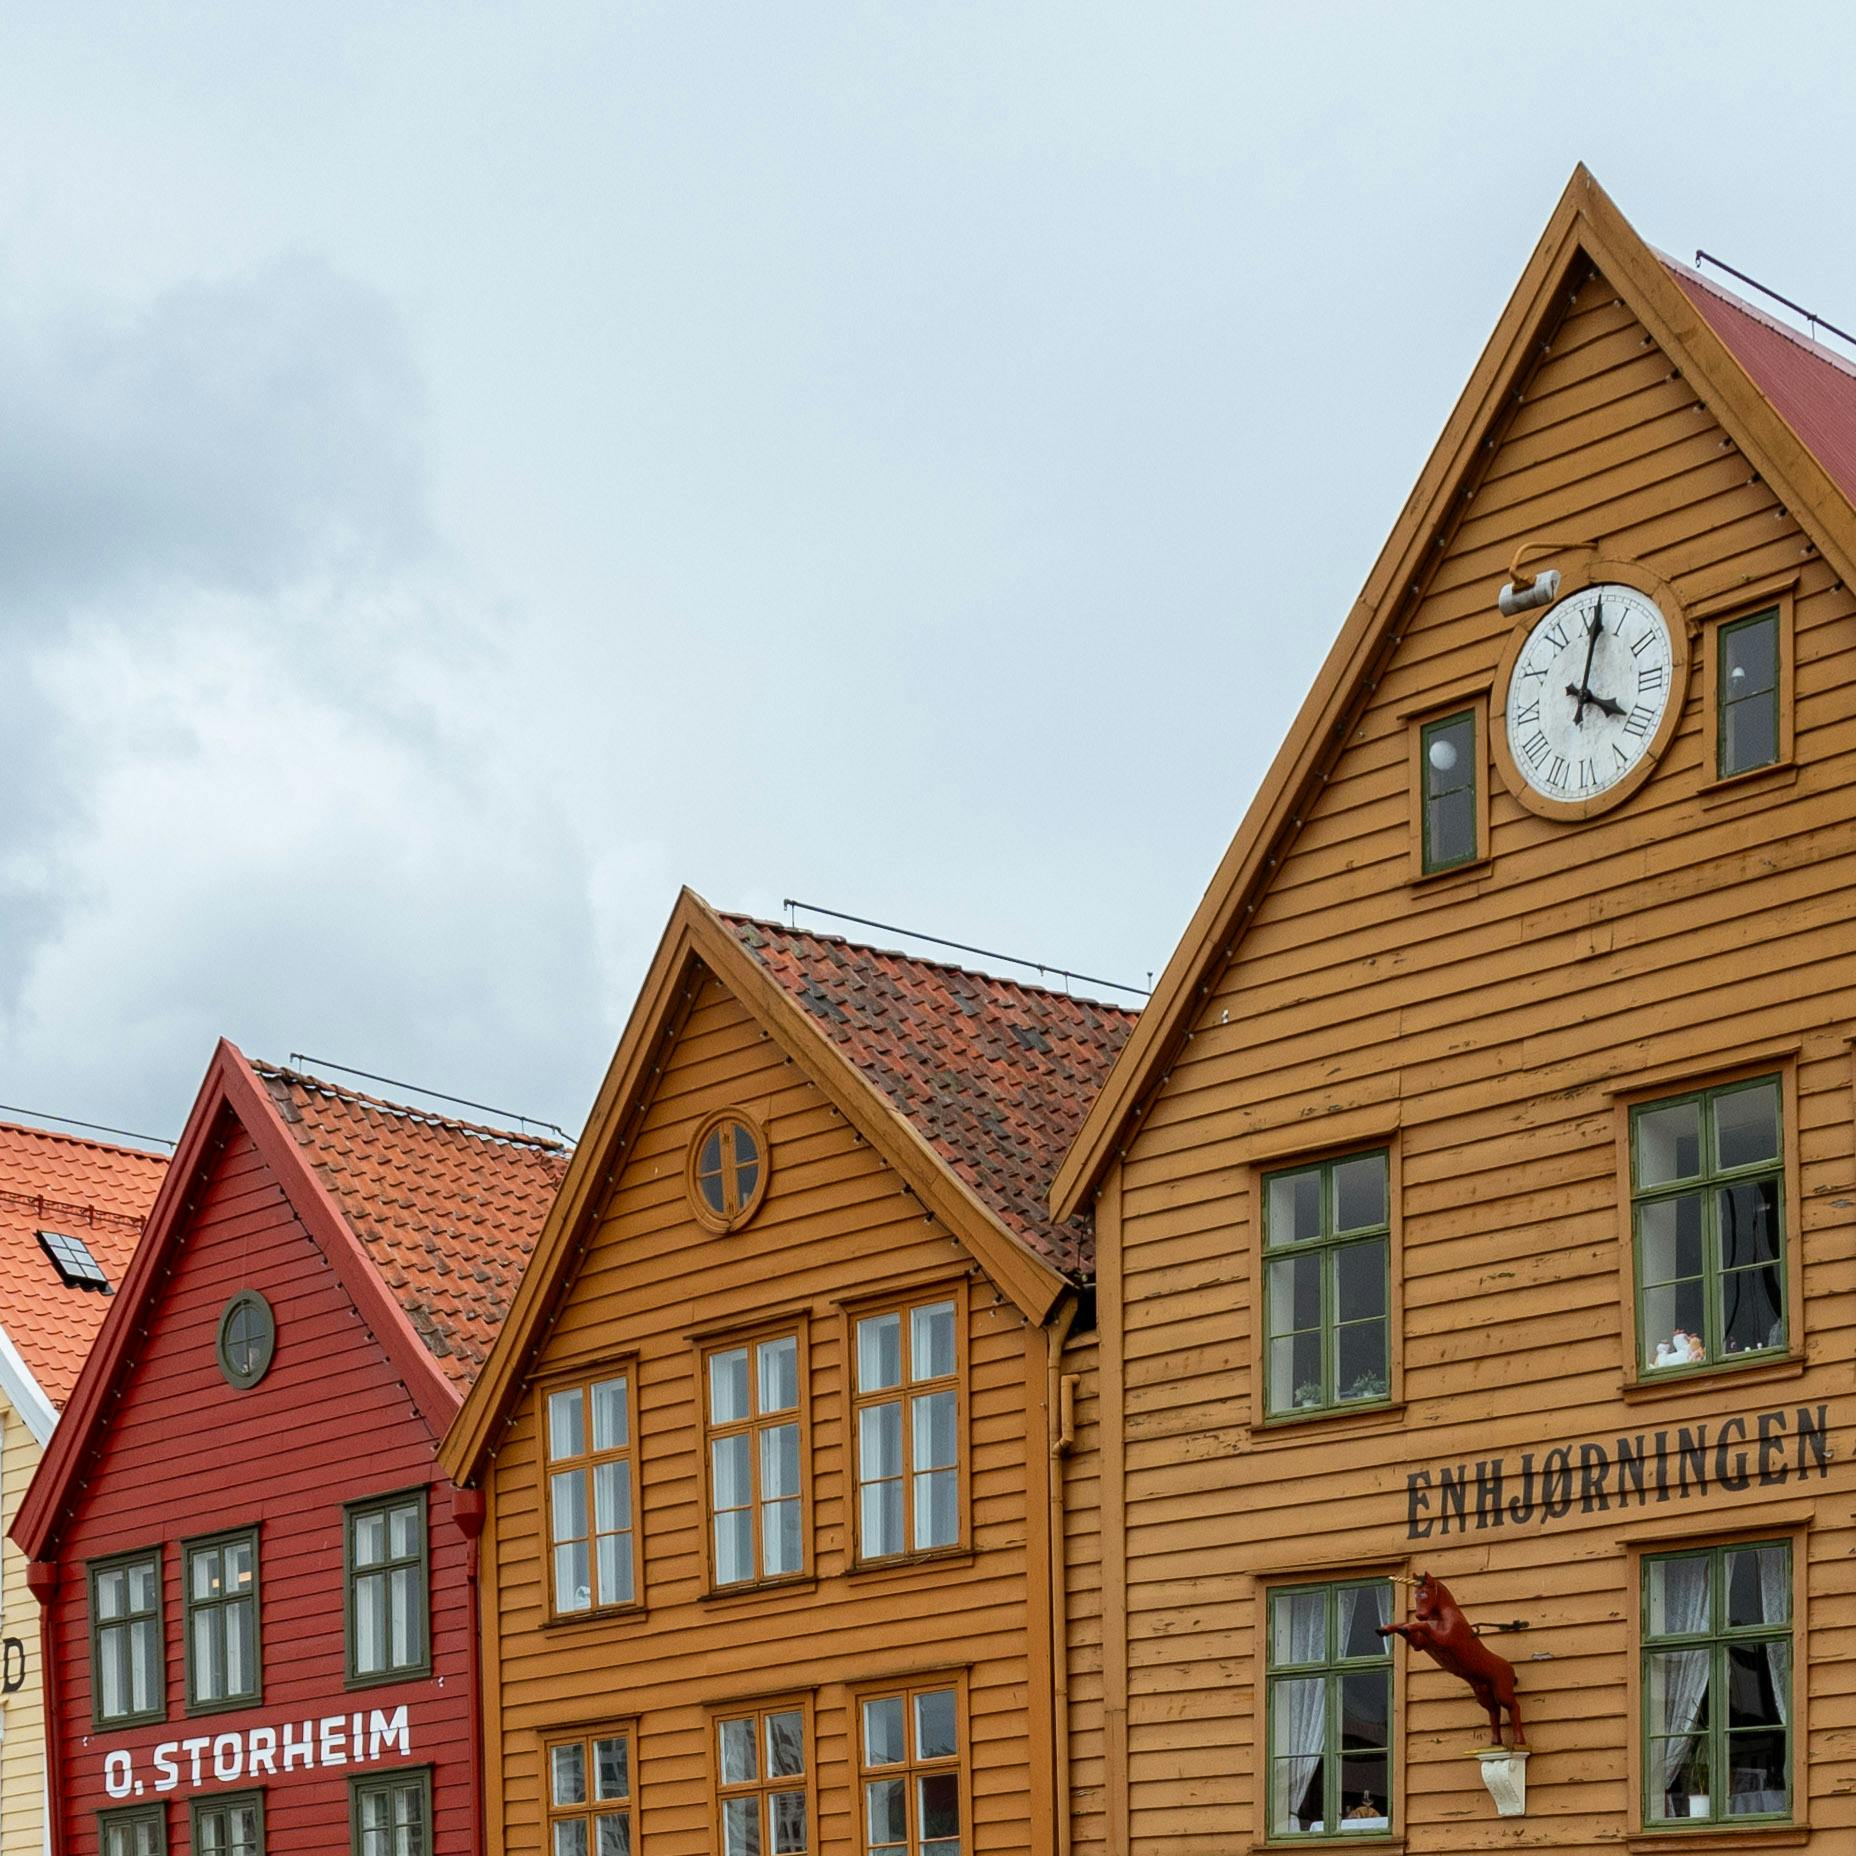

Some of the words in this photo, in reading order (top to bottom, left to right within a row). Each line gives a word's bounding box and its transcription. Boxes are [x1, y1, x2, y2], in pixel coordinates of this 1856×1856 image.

[1631, 628, 1657, 658] II
[1638, 666, 1663, 692] III
[1406, 1404, 1832, 1540] ENHJØRNINGEN
[104, 1750, 144, 1798] O.
[153, 1704, 411, 1792] STORHEIM
